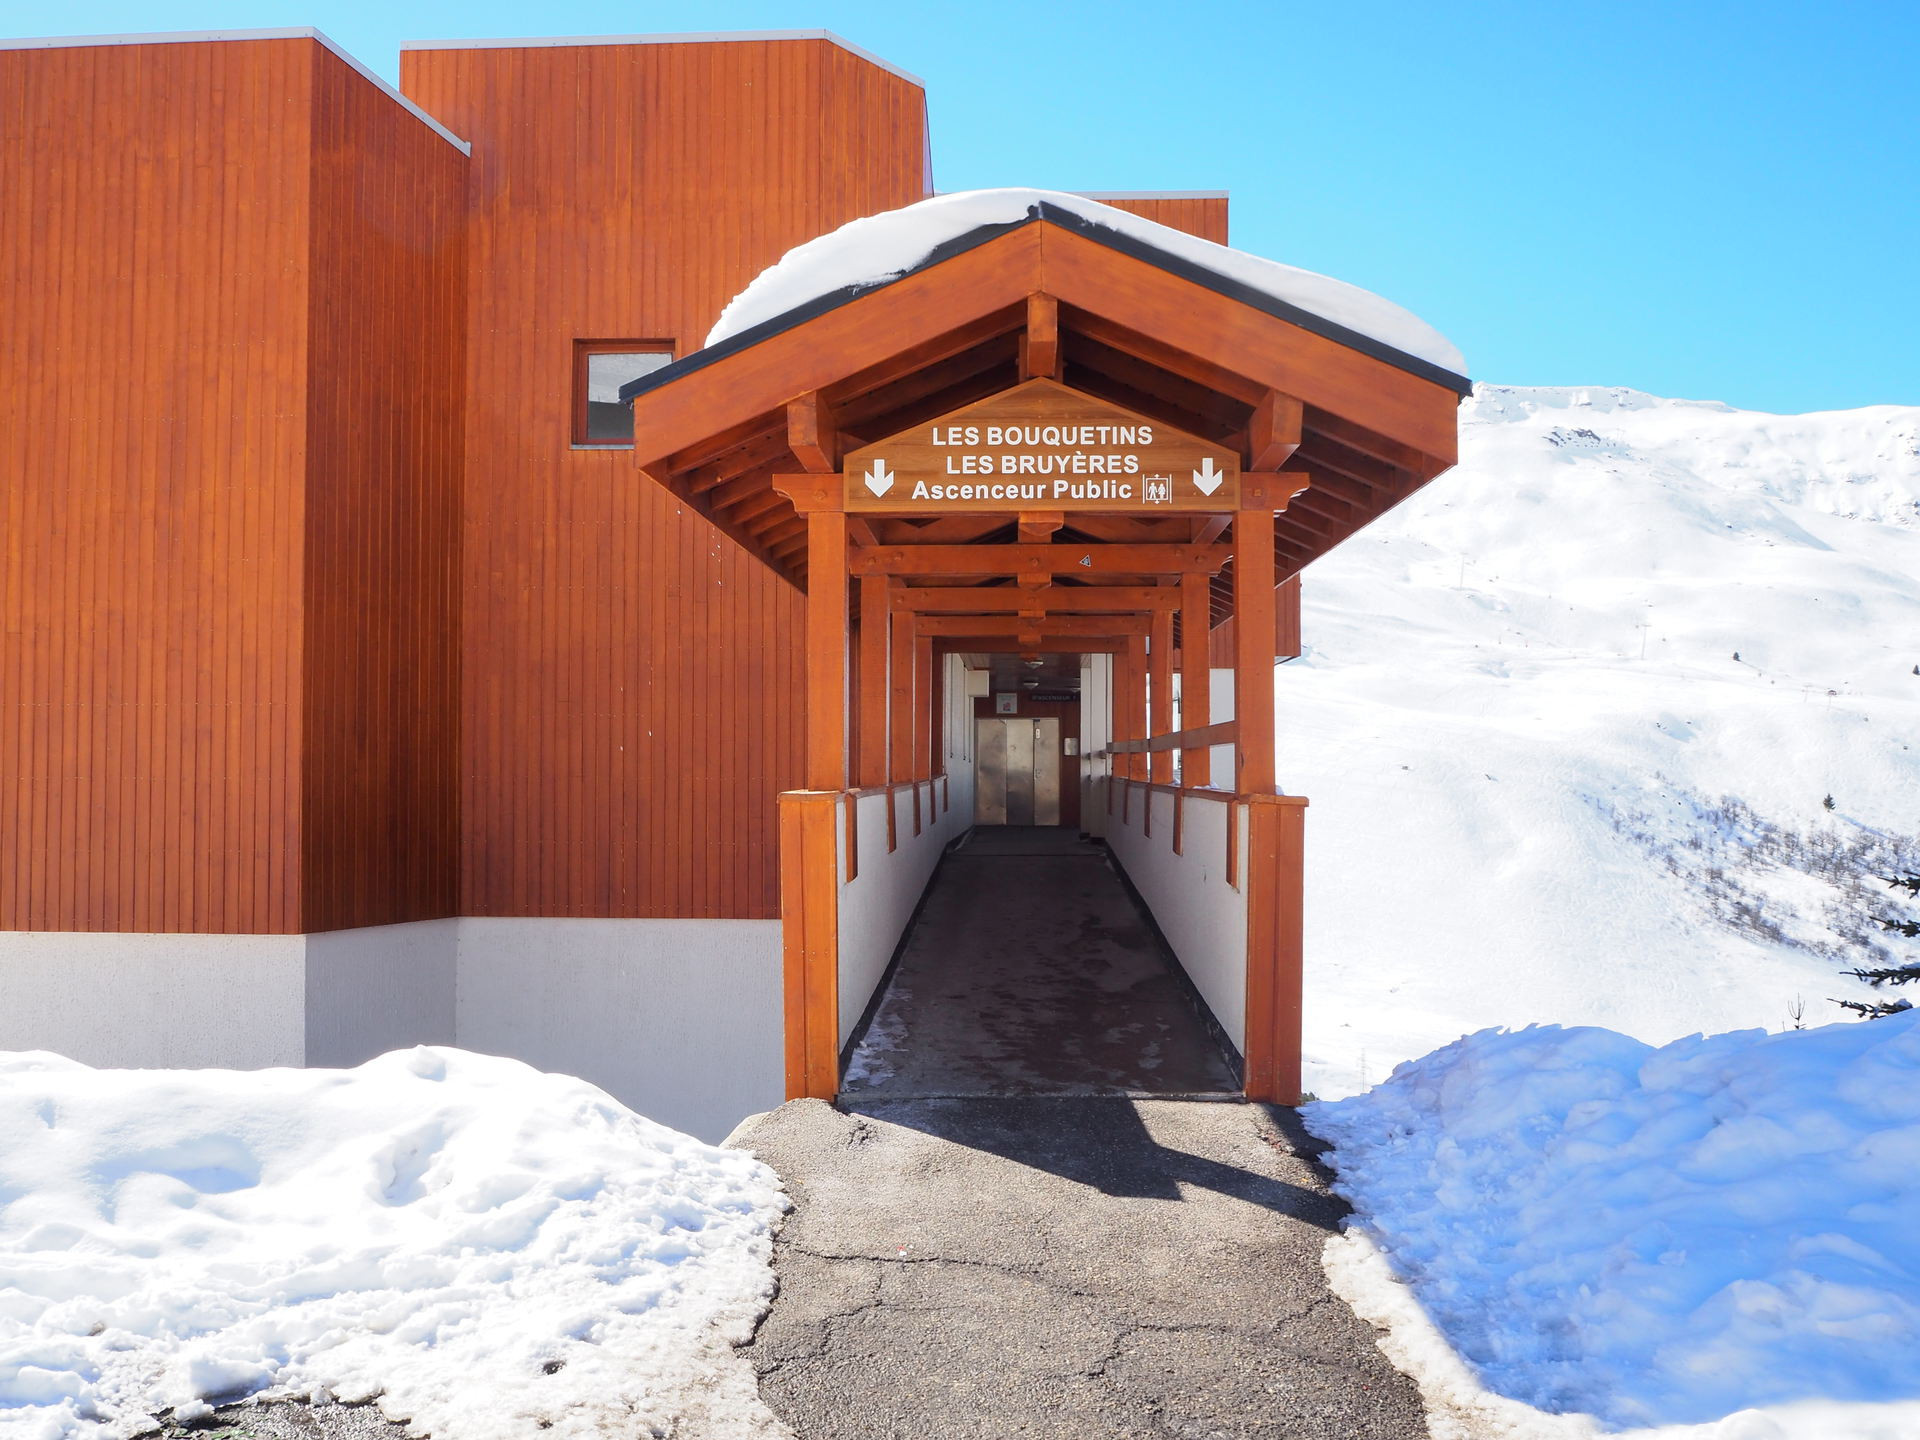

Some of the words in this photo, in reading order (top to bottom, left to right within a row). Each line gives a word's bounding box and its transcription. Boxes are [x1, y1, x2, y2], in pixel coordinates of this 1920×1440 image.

[932, 426, 979, 446] LES
[987, 426, 1152, 447] BOUQUETINS
[946, 455, 993, 474] LES
[1001, 450, 1138, 474] BRUYÈRES
[911, 480, 1046, 499] Ascenceur
[1053, 479, 1132, 499] Public
